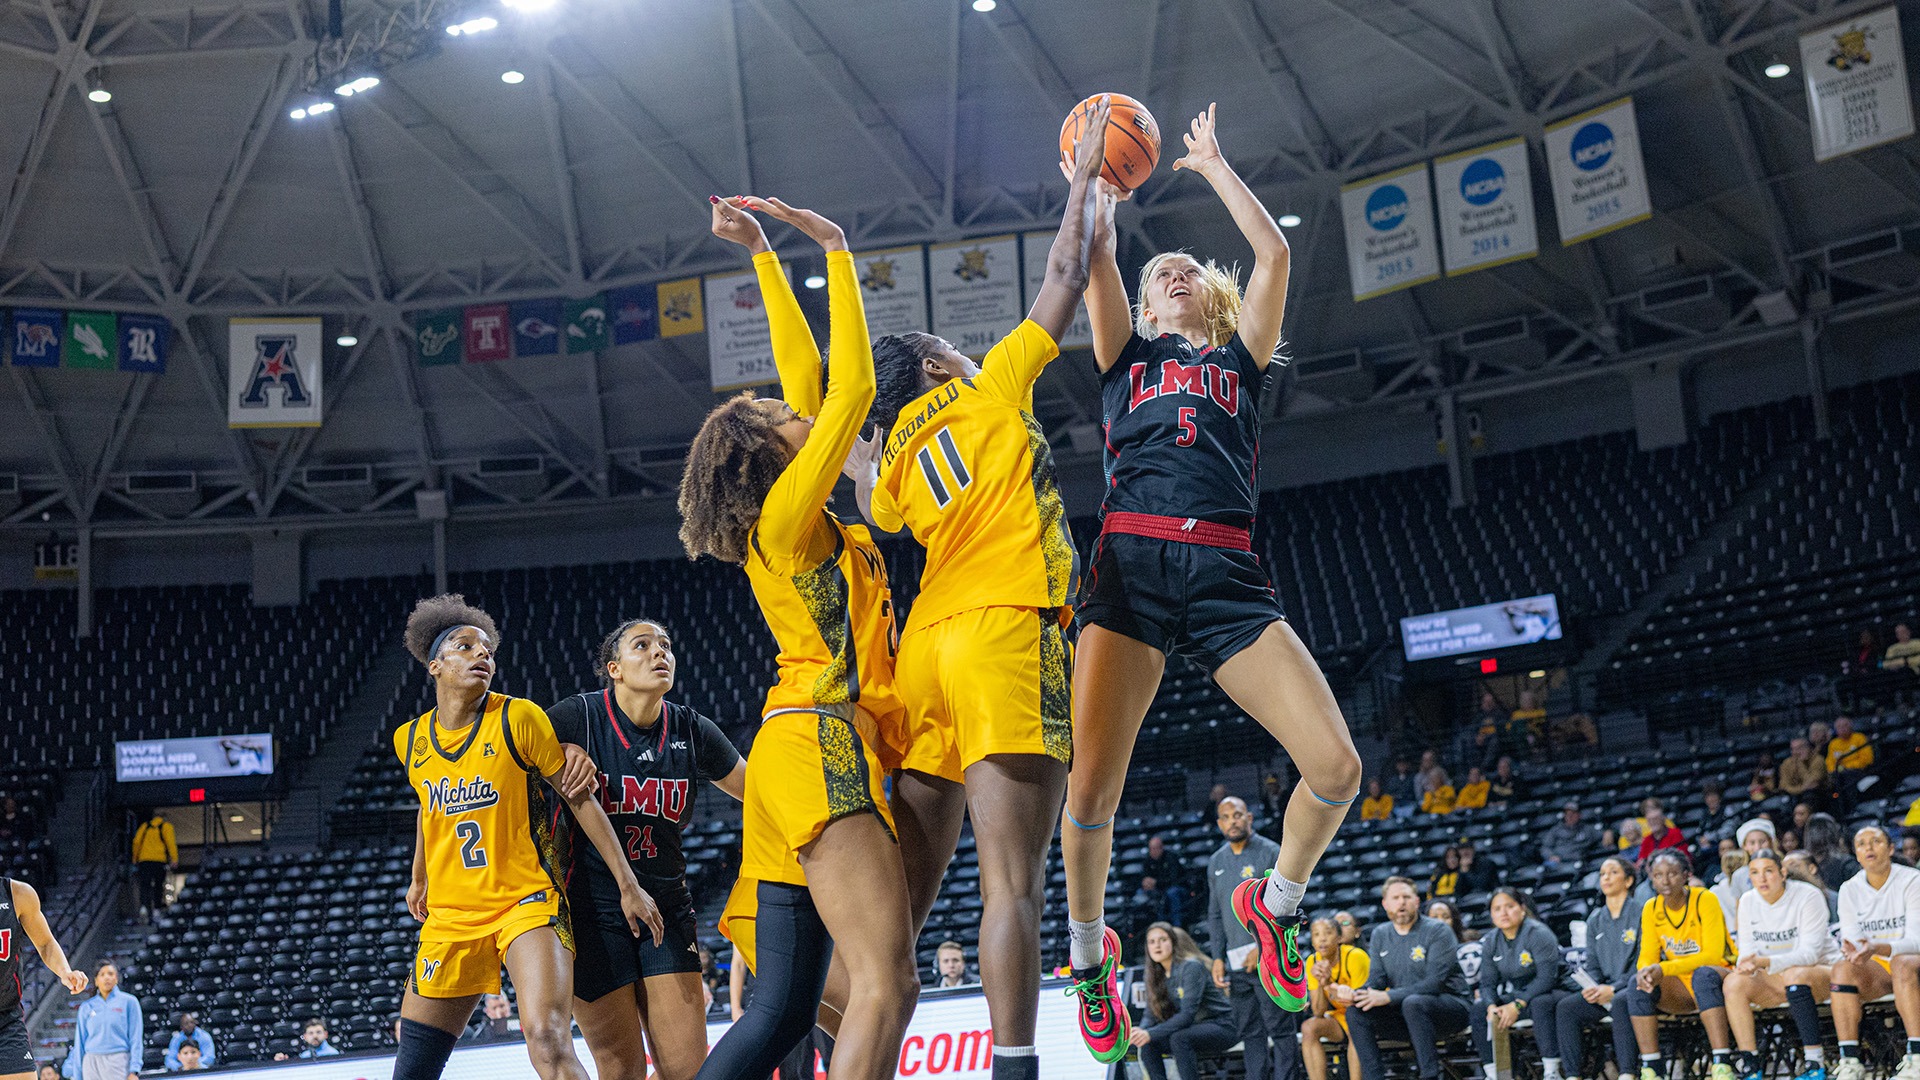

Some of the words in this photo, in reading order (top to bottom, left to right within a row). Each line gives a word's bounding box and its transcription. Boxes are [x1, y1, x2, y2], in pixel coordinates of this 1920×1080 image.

[1576, 138, 1617, 164] NCAA
[1465, 176, 1507, 198] NCAA
[1571, 164, 1625, 189] Women's
[1571, 177, 1628, 205] Basketball
[1370, 201, 1410, 224] NCAA
[1460, 199, 1515, 221] Women's
[1460, 213, 1518, 236] Basketball
[1366, 226, 1417, 248] Women's
[1472, 232, 1511, 256] 2014
[1365, 237, 1420, 263] Basketball
[961, 331, 995, 349] 2014
[1128, 357, 1240, 418] LMU
[1175, 406, 1198, 448] 5
[916, 424, 973, 511] 11
[1407, 617, 1447, 630] YOU'RE
[1408, 629, 1450, 643] GONNA
[121, 756, 165, 766] GONNA
[168, 753, 197, 763] NEED
[122, 744, 163, 754] YOU'RE
[122, 766, 152, 776] MILK
[154, 764, 177, 775] FOR
[178, 762, 210, 774] THAT.
[422, 774, 500, 813] Wichita
[598, 771, 689, 824] LMU
[447, 804, 470, 814] STATE
[456, 819, 489, 870] 2
[624, 824, 659, 861] 24
